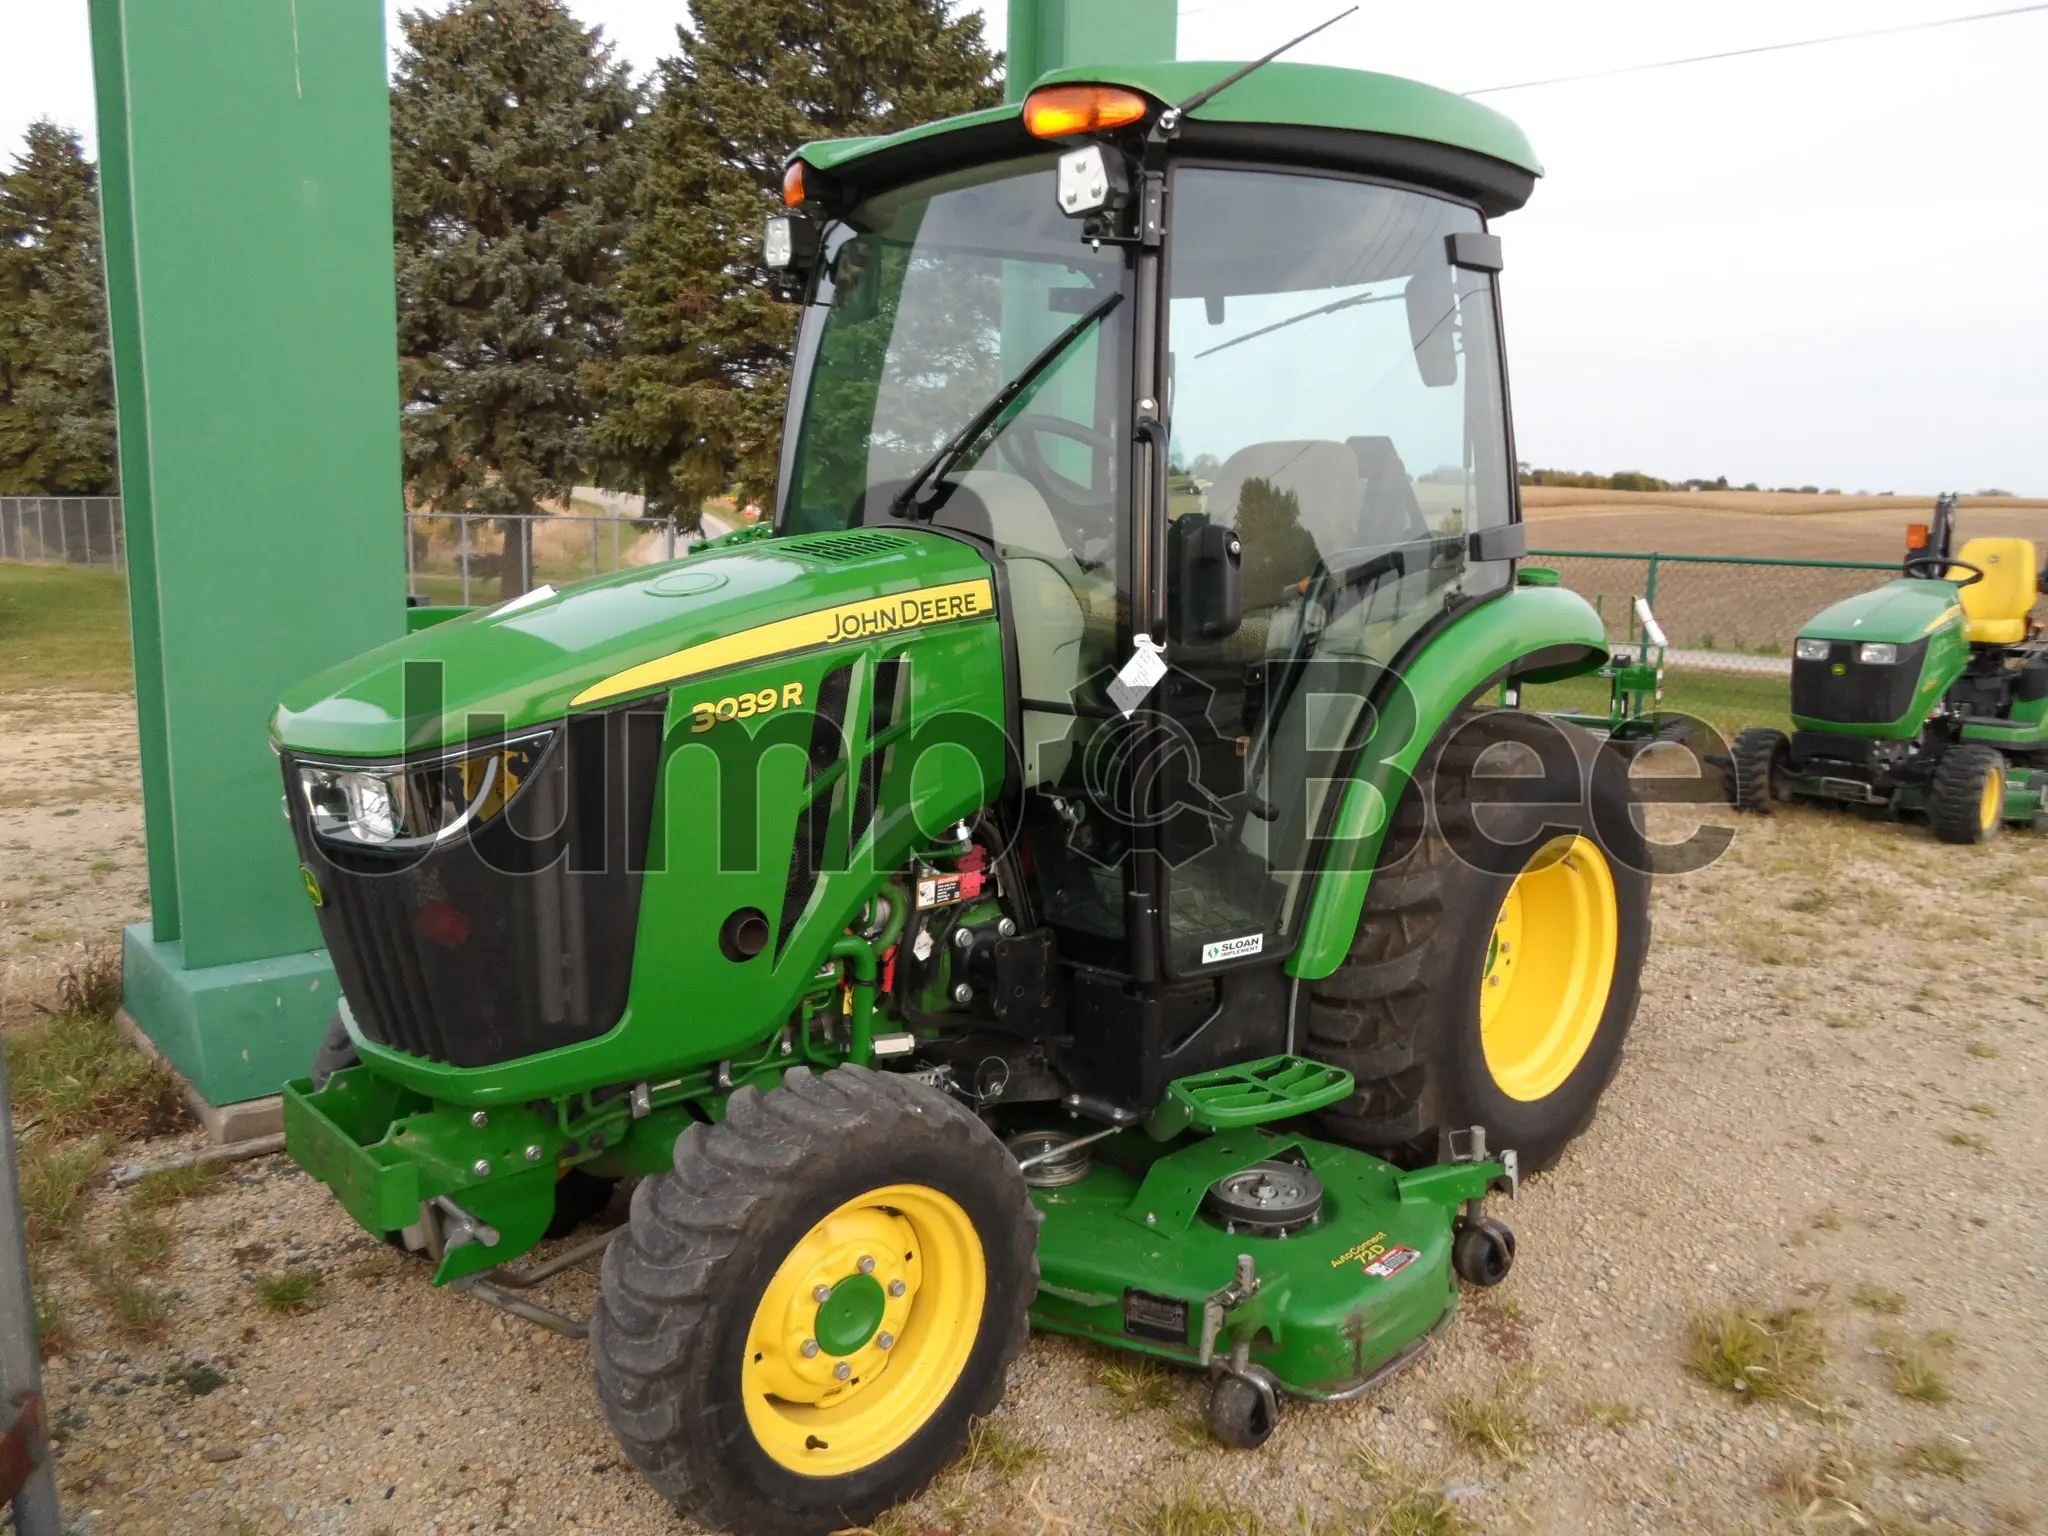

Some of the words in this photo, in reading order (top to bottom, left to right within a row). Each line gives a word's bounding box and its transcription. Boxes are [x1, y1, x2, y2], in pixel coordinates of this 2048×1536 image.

[827, 607, 897, 640] JOHN
[901, 593, 977, 624] DEERE
[1220, 945, 1259, 958] IMPLEMENT
[1221, 937, 1260, 952] SLOAN
[1330, 1231, 1387, 1268] AutoConnect
[1353, 1244, 1386, 1265] 72D
